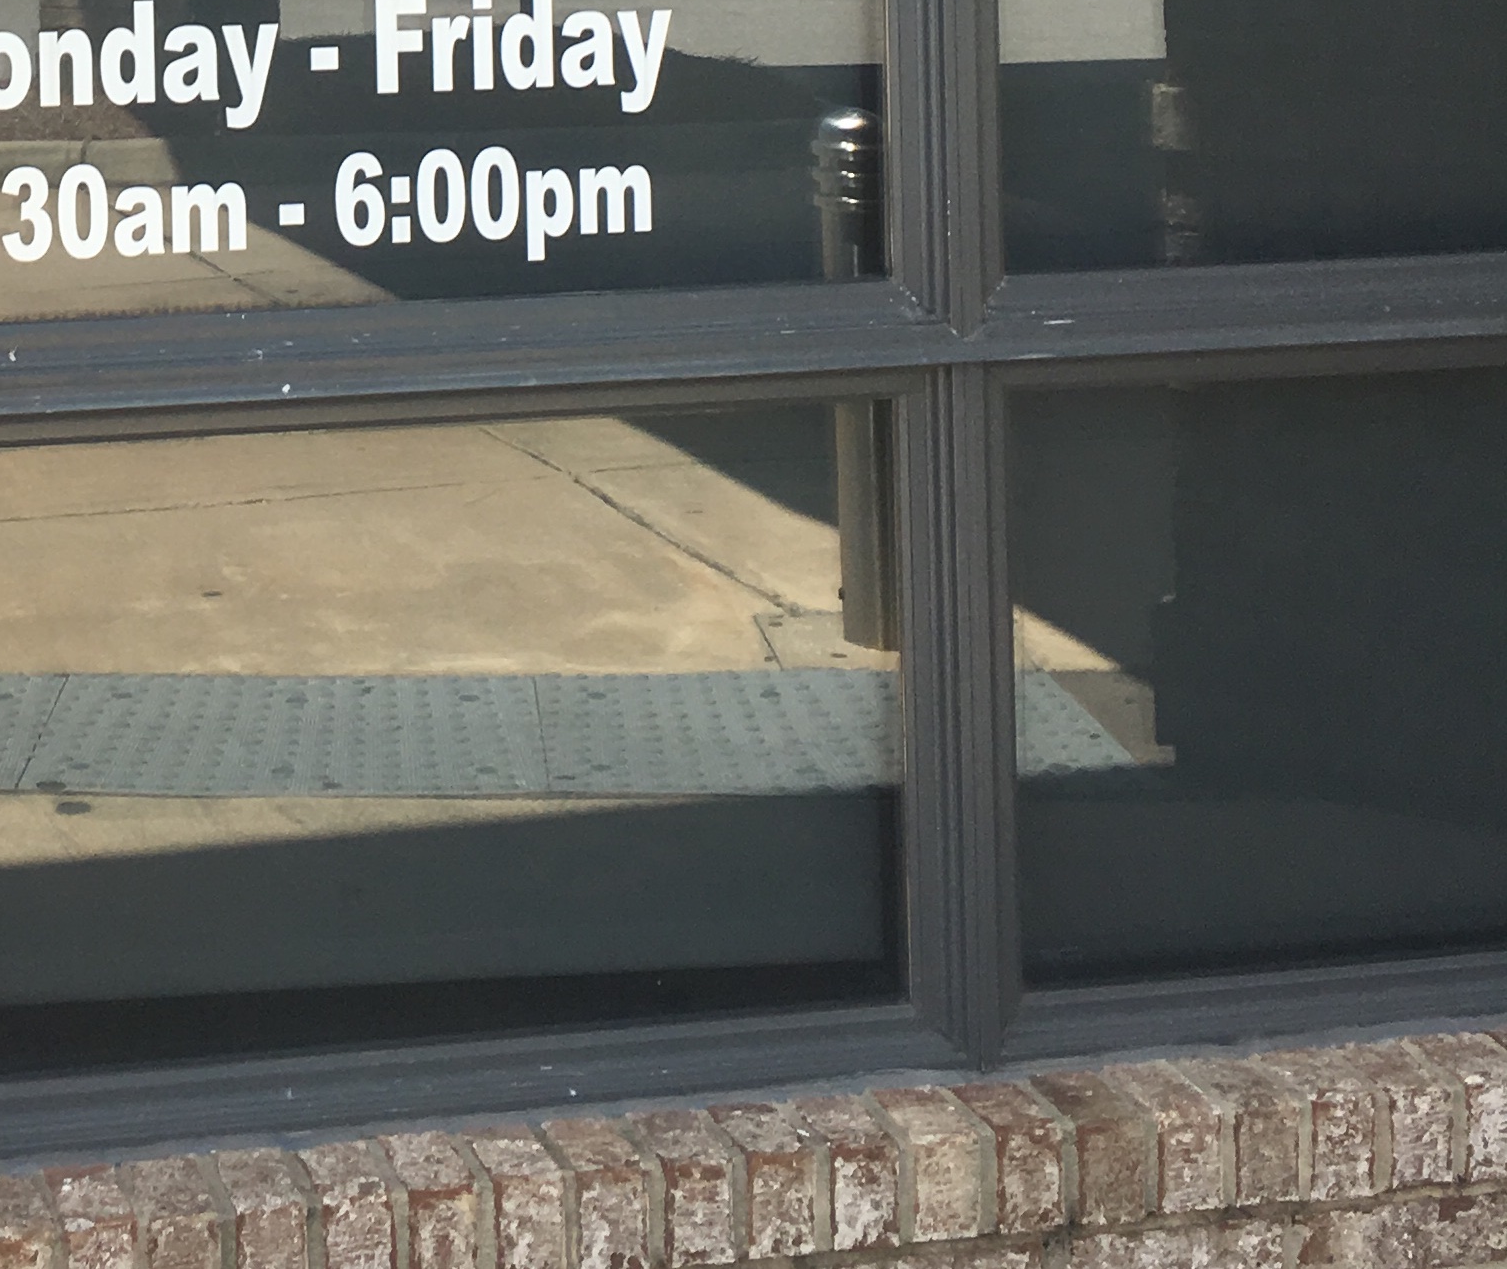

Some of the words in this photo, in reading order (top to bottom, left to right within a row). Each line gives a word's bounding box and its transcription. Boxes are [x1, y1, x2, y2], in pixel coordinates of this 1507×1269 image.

[310, 46, 340, 71] -
[278, 202, 305, 226] -
[334, 146, 653, 262] 6:00pm
